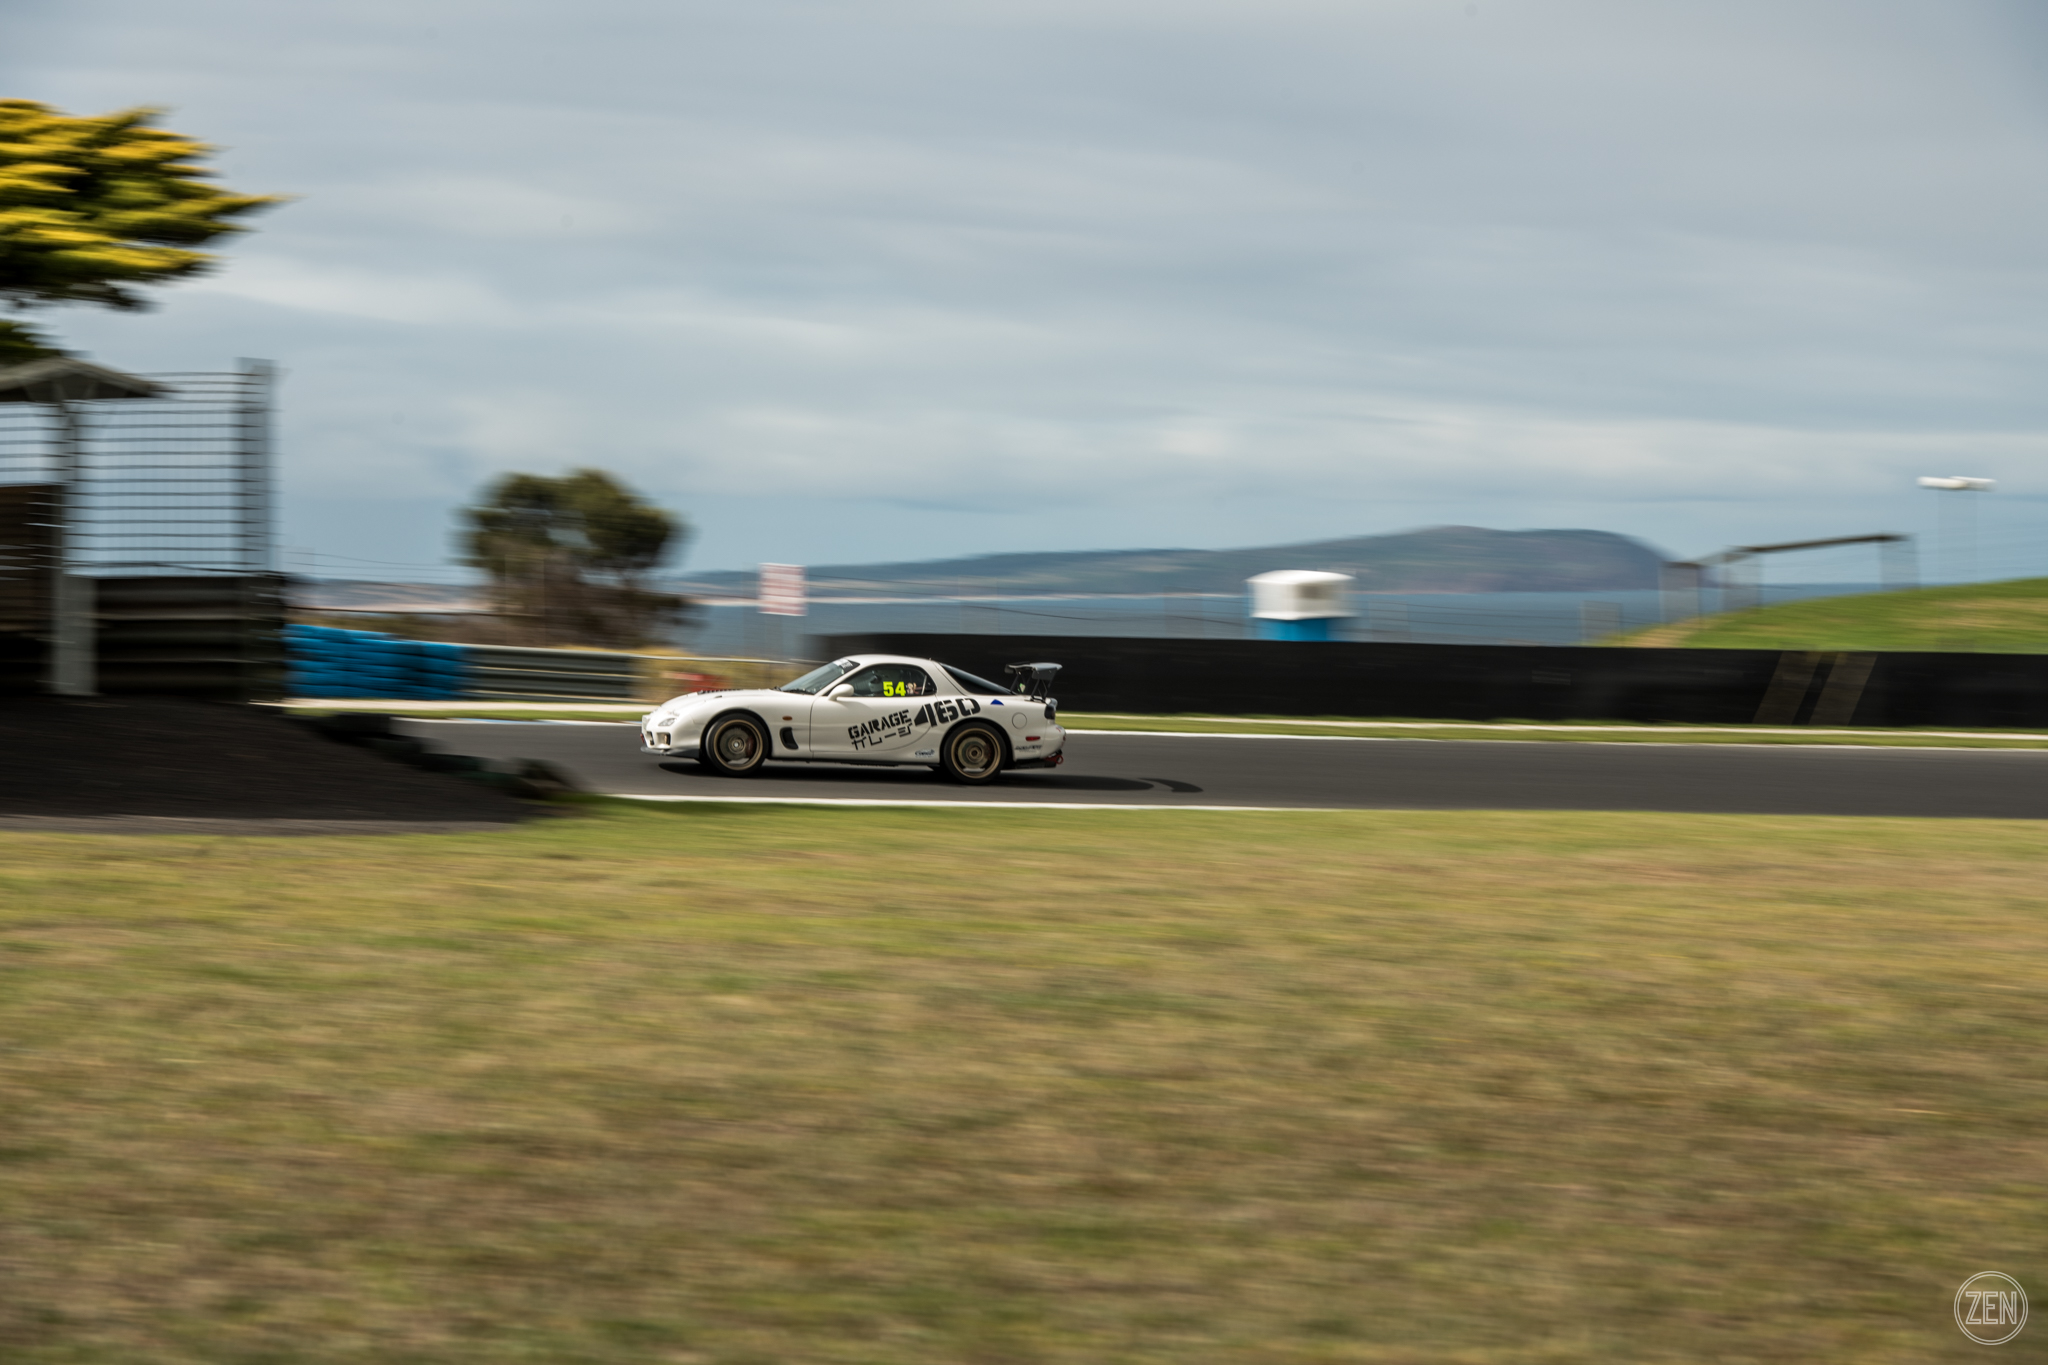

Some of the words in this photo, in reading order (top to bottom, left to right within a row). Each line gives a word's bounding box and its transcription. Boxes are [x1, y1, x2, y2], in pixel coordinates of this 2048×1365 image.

[883, 681, 906, 697] 54
[848, 709, 912, 739] GARAGE
[914, 698, 981, 728] 460
